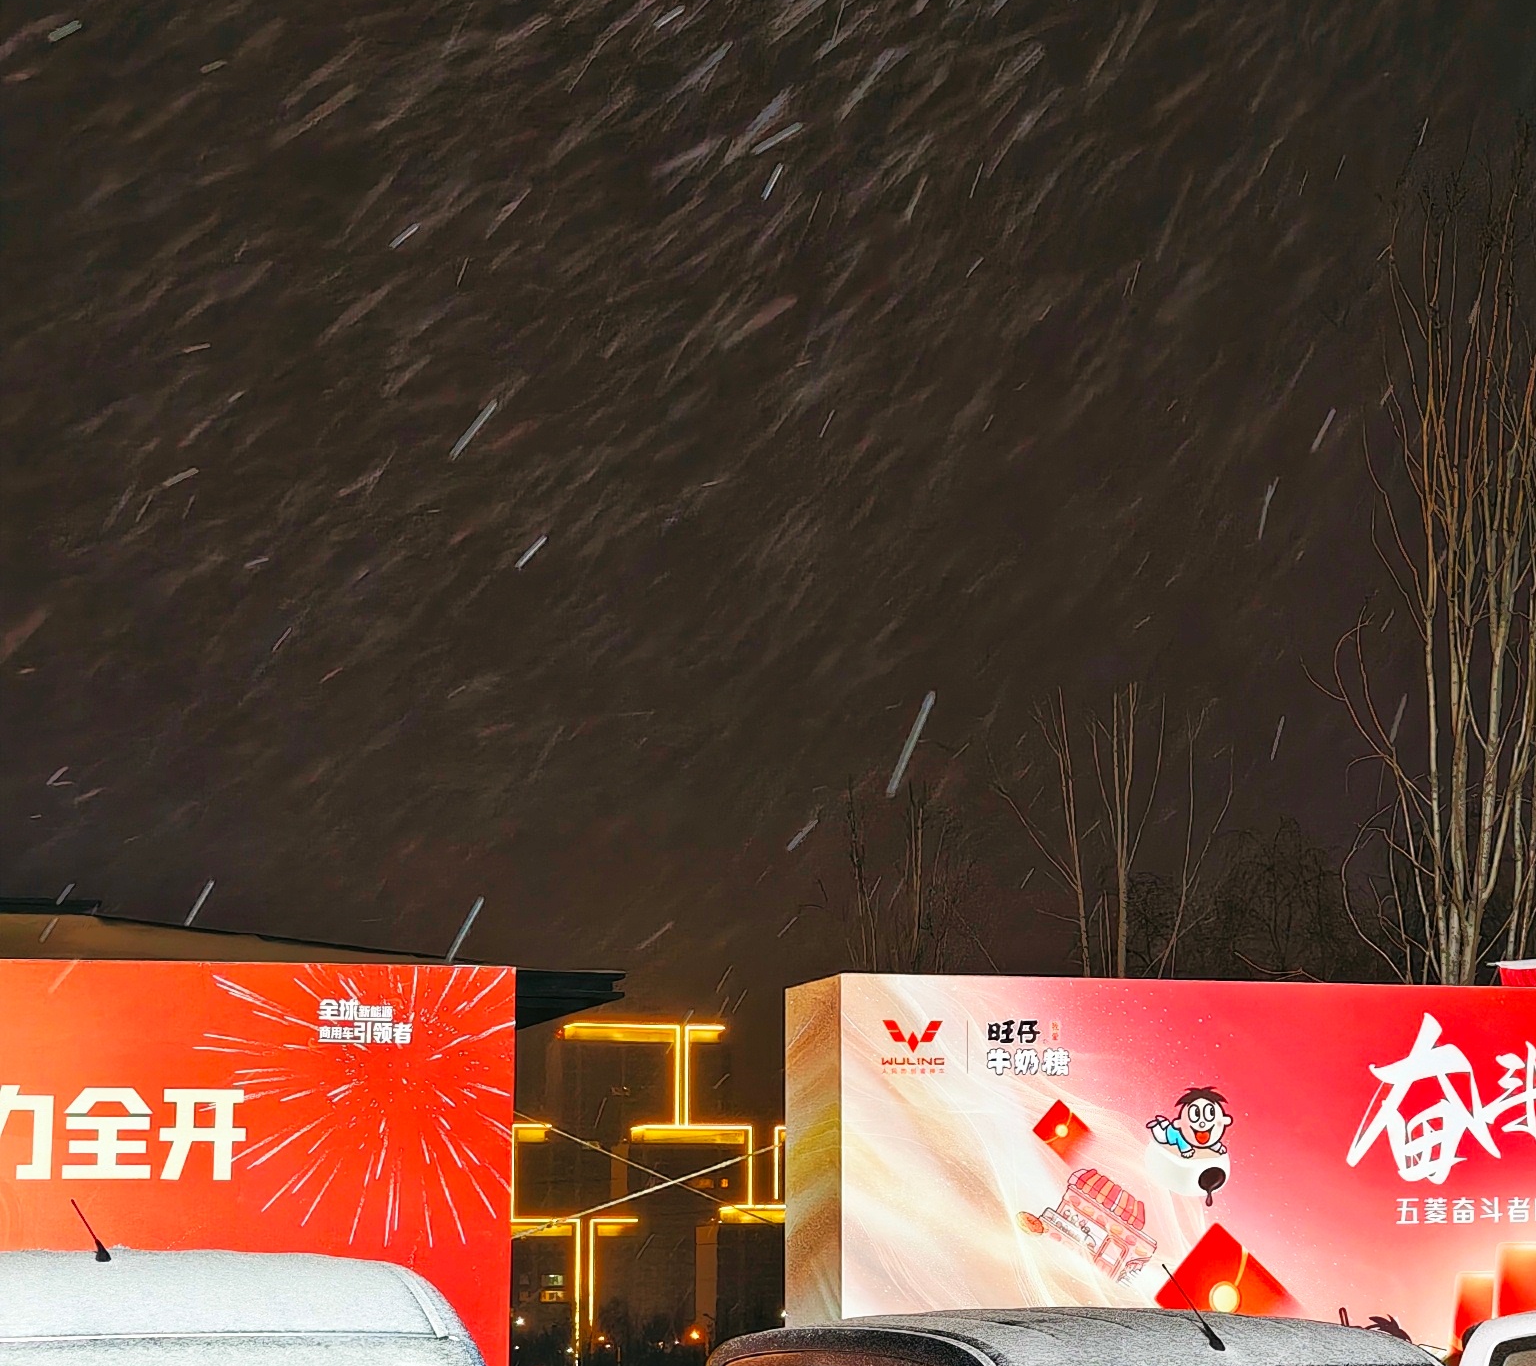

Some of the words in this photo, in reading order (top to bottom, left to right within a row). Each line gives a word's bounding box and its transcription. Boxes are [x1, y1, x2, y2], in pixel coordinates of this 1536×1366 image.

[318, 1021, 413, 1044] 商用车引领者
[987, 1020, 1041, 1044] 旺仔
[881, 1057, 945, 1065] WULING
[986, 1047, 1071, 1076] 牛奶糖
